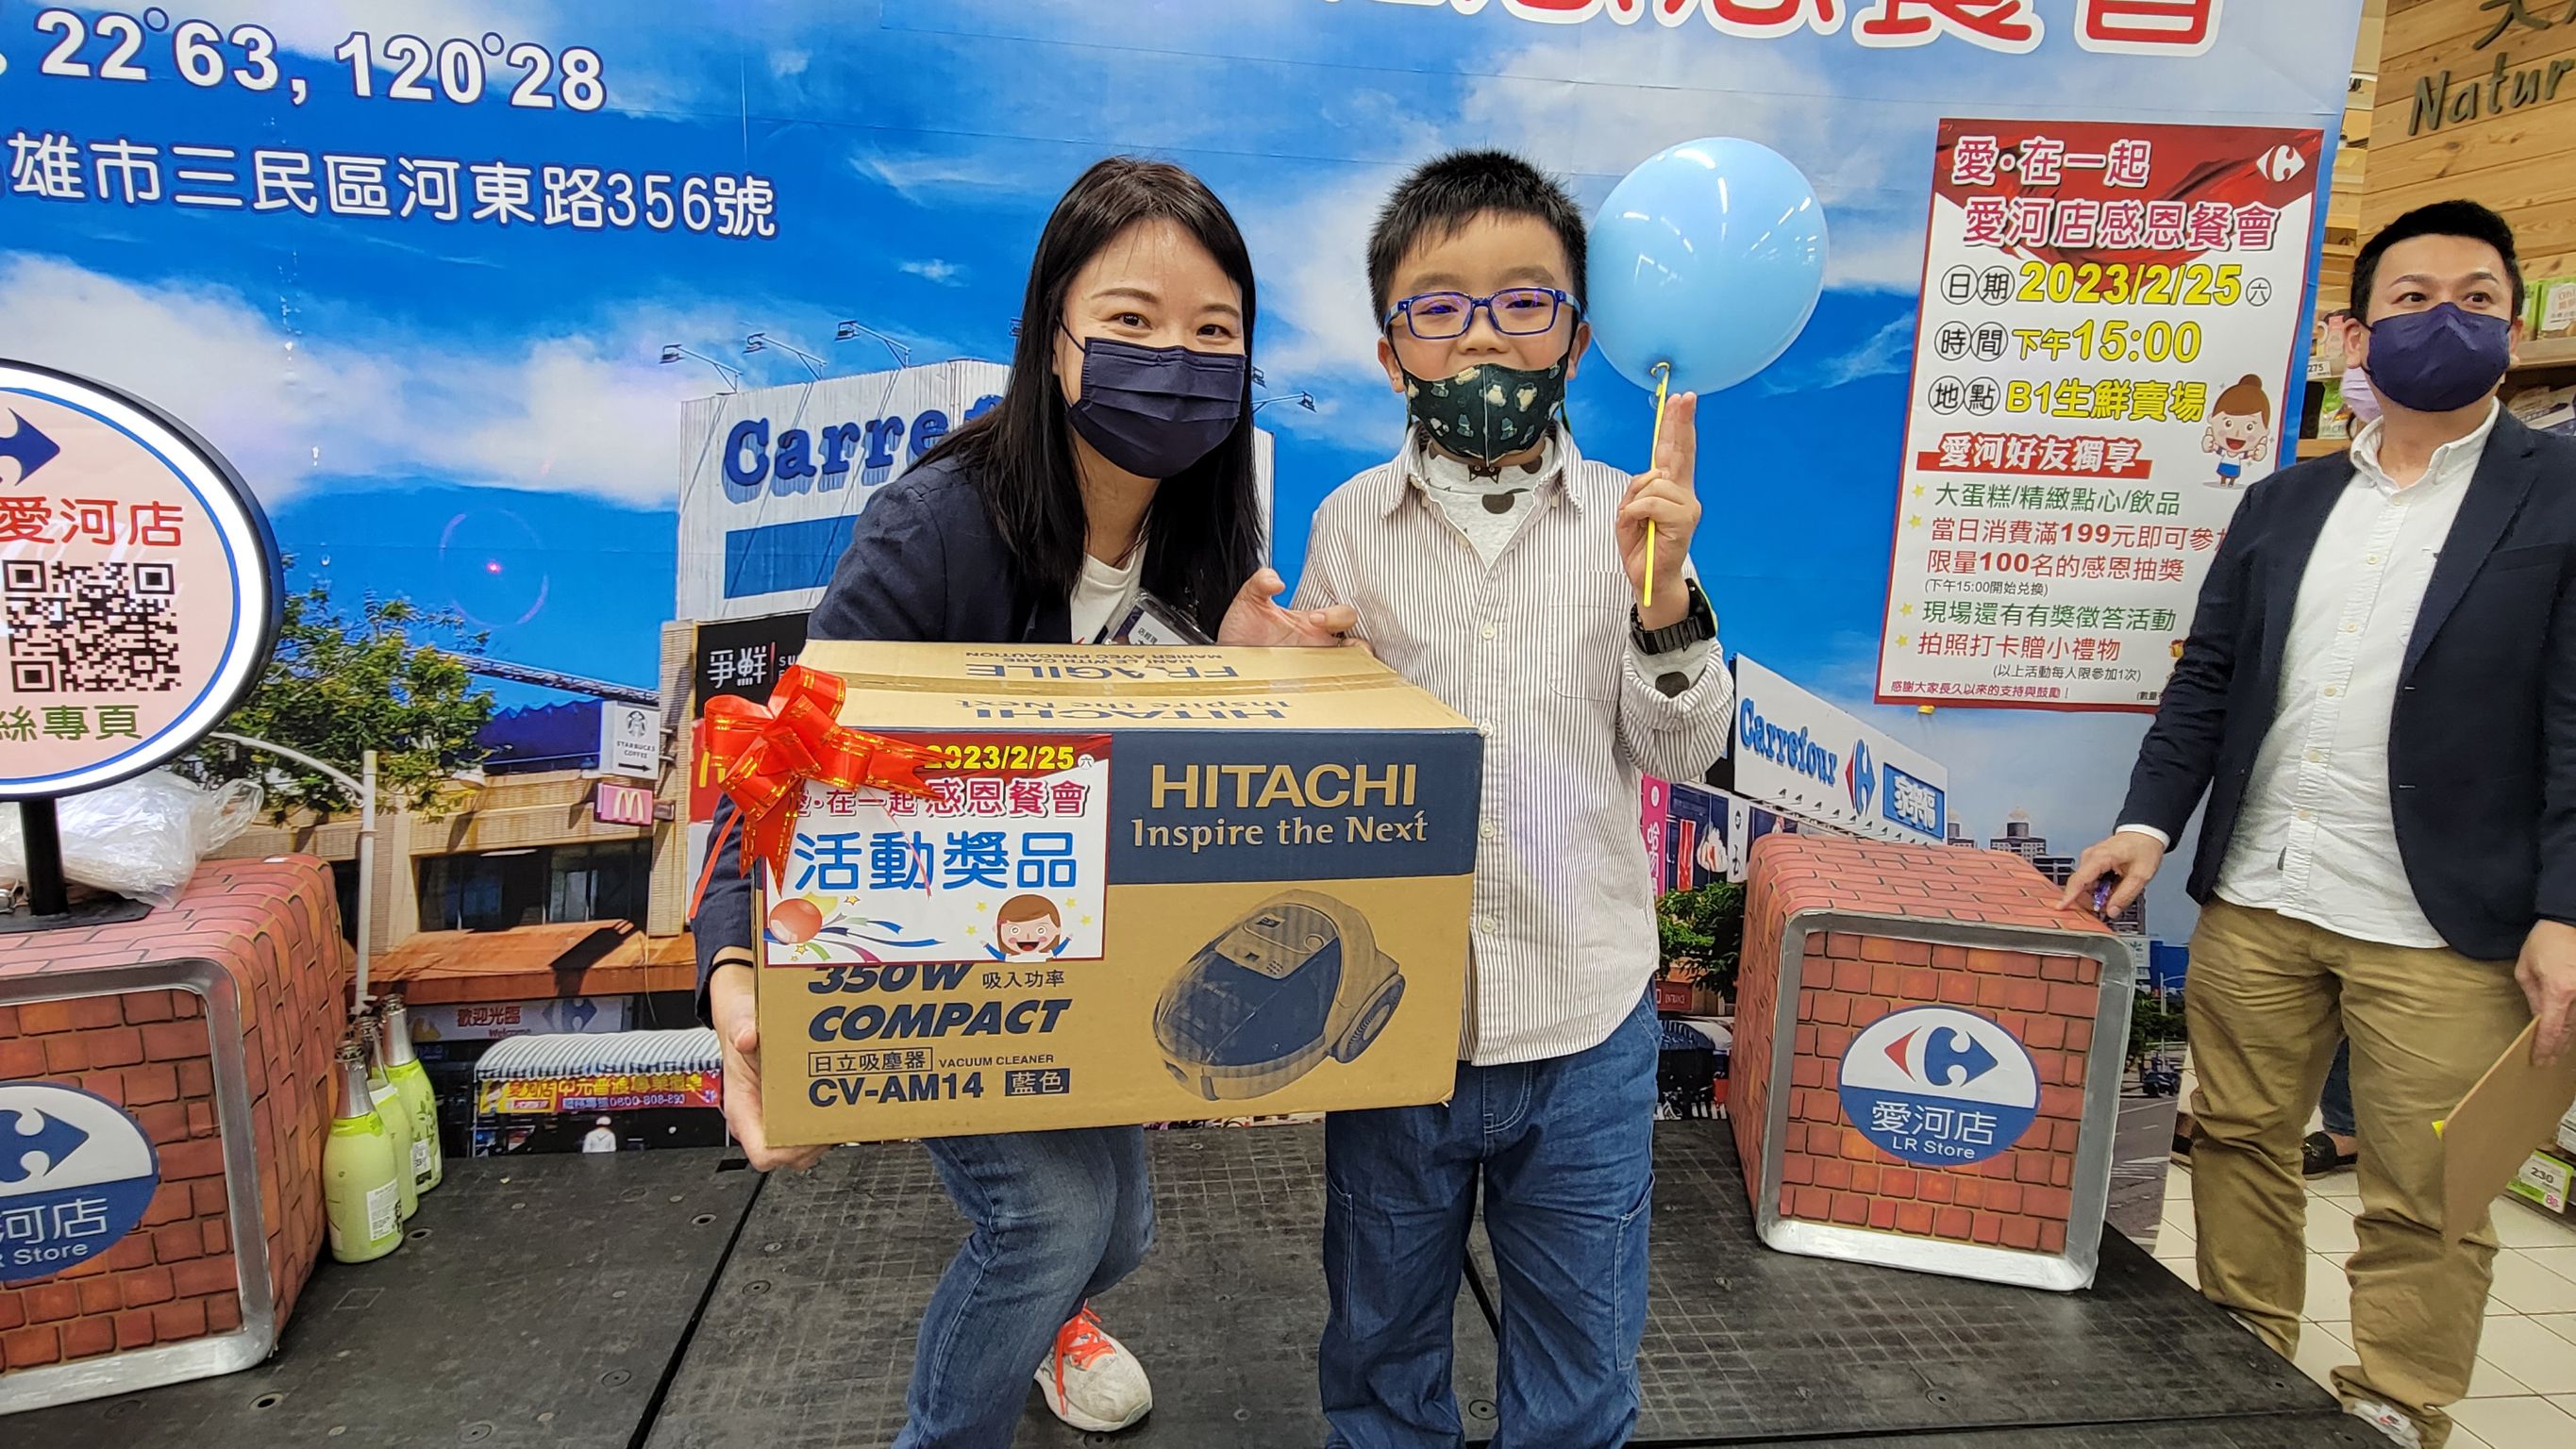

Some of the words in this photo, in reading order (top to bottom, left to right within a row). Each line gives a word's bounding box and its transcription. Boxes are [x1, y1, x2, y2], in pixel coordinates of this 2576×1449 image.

[2408, 52, 2576, 137] Natur
[8, 131, 777, 238] 雄市三民區河東路356號
[1964, 198, 2282, 251] 愛河店感恩餐會
[2016, 262, 2242, 306] 2023/2/25
[2007, 379, 2207, 423] B1生鮮賣場
[724, 394, 1006, 487] Carre
[1938, 433, 2141, 474] 愛河好友獨享
[0, 495, 185, 547] 愛河店
[1934, 482, 2181, 516] 大蛋糕/精緻點心/飲品
[1927, 549, 2185, 583] 限量100名的感恩抽獎
[1921, 600, 2177, 632] 現場還有有獎徵答活動
[707, 645, 768, 689] 爭鮮
[1916, 631, 2122, 662] 拍照打卡贈小禮物
[1150, 763, 1417, 808] HITACHI
[1131, 817, 1264, 853] Inspire
[1277, 815, 1335, 844] the
[1346, 809, 1429, 843] Next
[794, 830, 1078, 891] 活動獎品
[808, 964, 976, 994] 350W
[982, 969, 1065, 990] 吸入功率
[808, 998, 1074, 1042] COMPACT
[814, 1049, 927, 1074] 日立吸塵器
[939, 1057, 993, 1068] VACUUM
[996, 1053, 1054, 1065] CLEANER
[809, 1072, 984, 1108] CV-AM14
[1010, 1069, 1065, 1095] 藍色
[1870, 1100, 1999, 1146] 愛河店
[1893, 1136, 1918, 1152] LR
[1923, 1140, 1976, 1159] Store
[14, 1243, 89, 1265] Store
